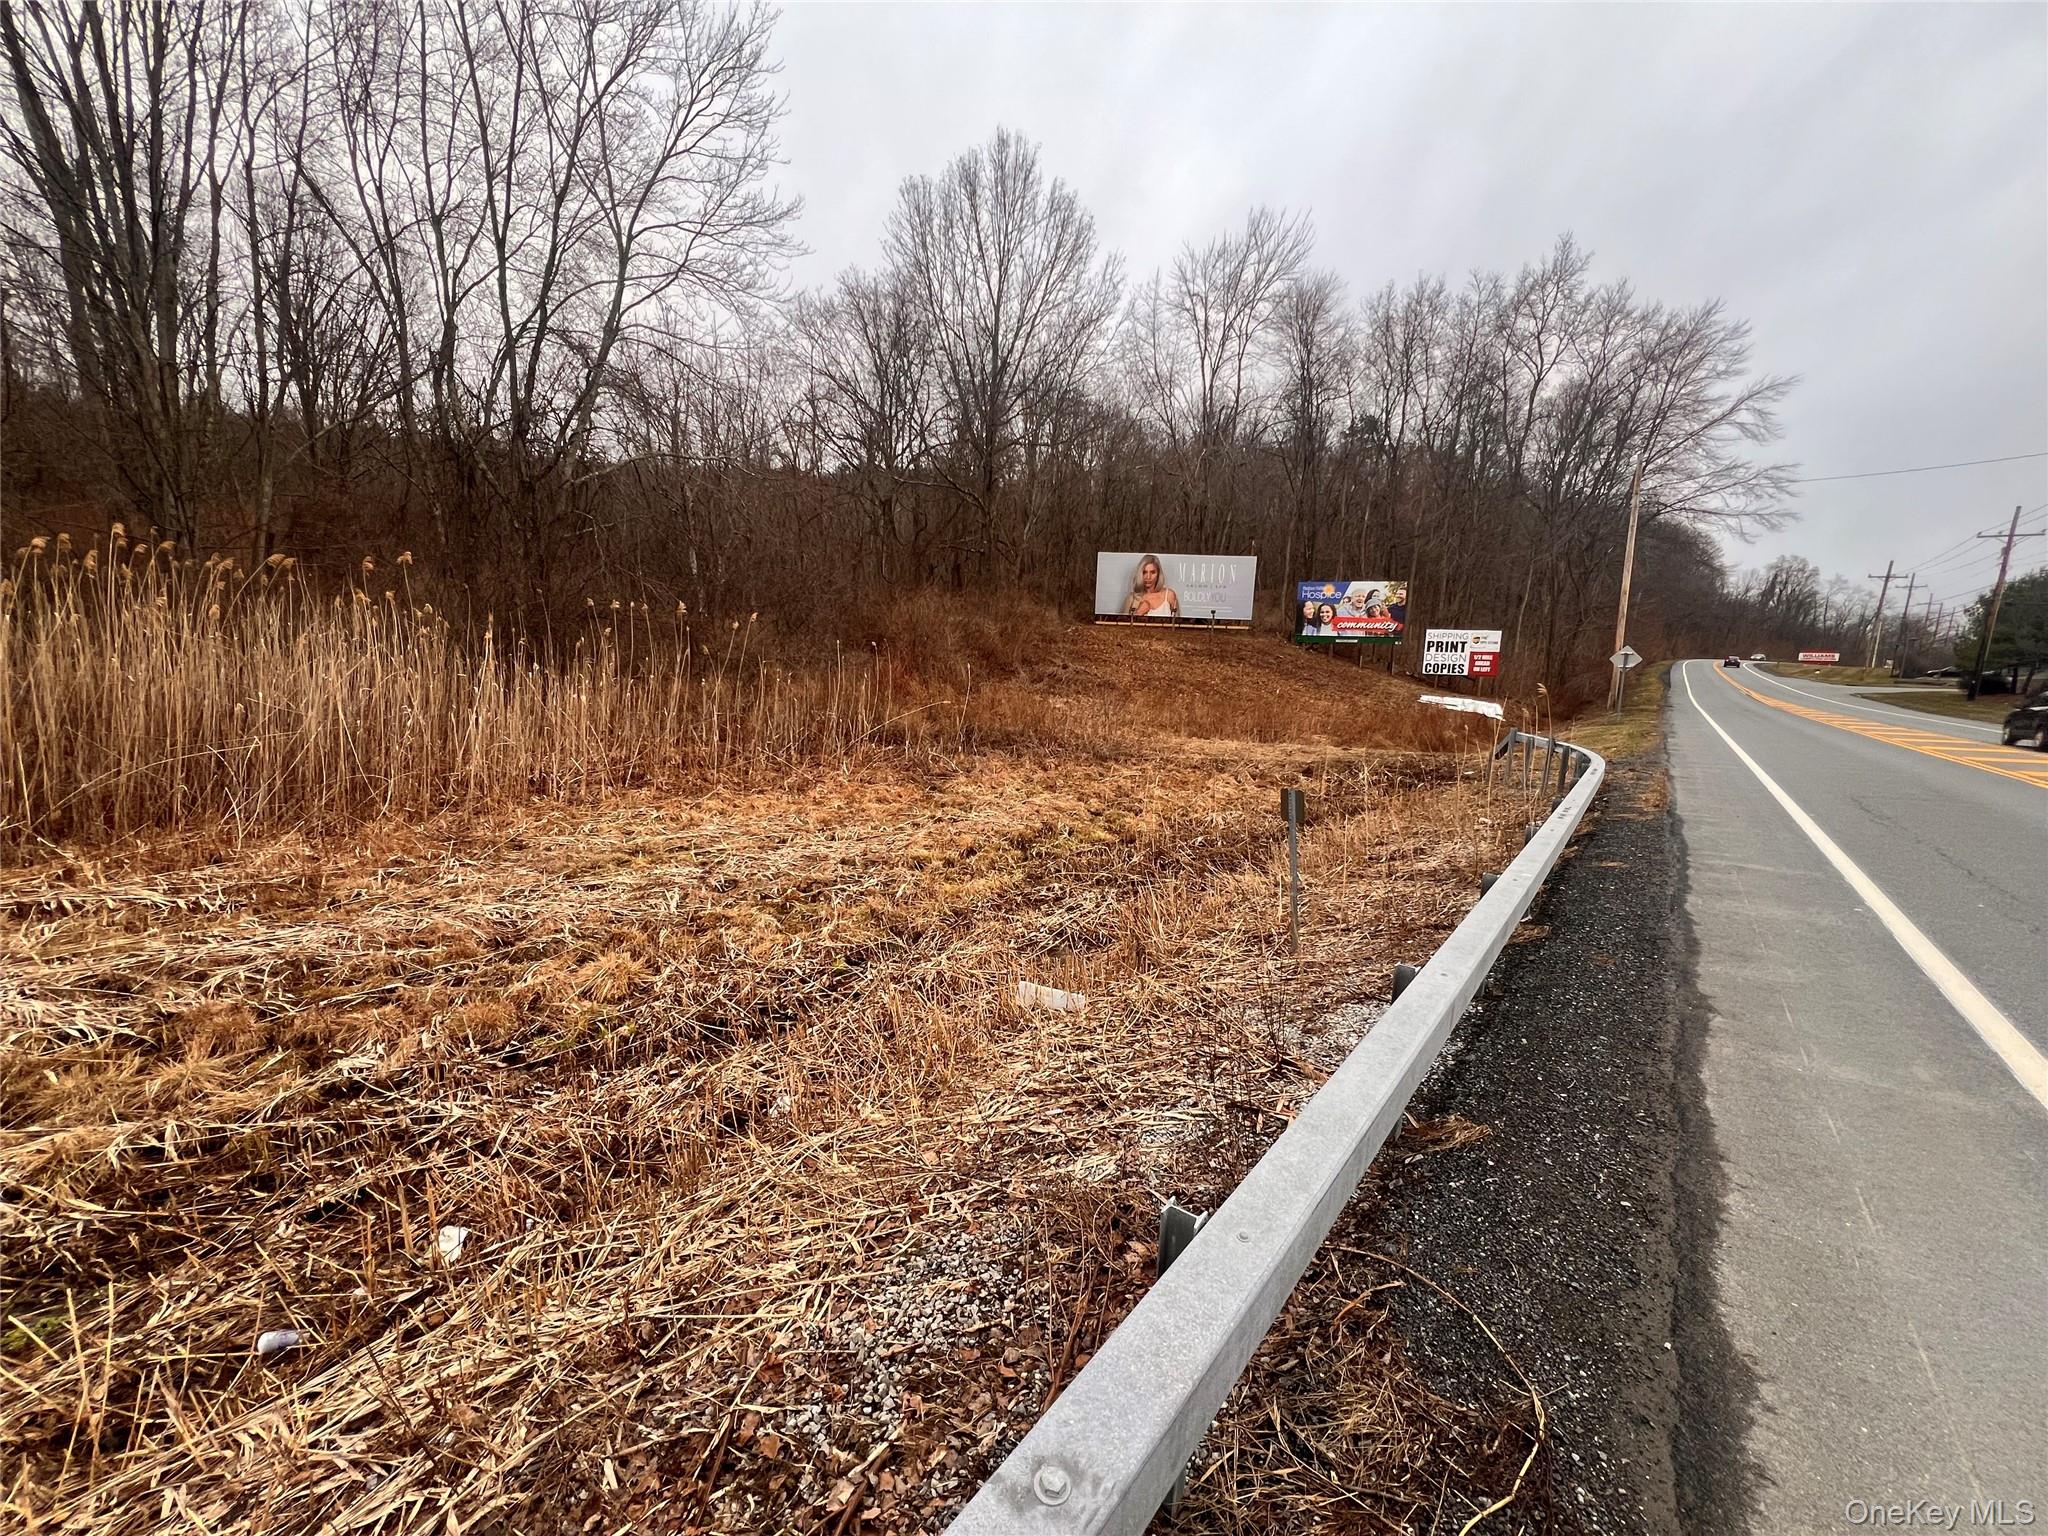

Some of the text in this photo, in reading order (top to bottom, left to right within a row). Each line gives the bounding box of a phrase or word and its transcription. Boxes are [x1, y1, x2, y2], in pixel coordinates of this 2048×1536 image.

[1178, 562, 1239, 584] MARION
[1302, 590, 1342, 600] Hospice
[1336, 621, 1397, 632] community
[1427, 632, 1469, 640] SHIPPING
[1426, 641, 1467, 653] PRINT
[1425, 653, 1466, 662] DESIGN
[1424, 663, 1464, 674] COPIES
